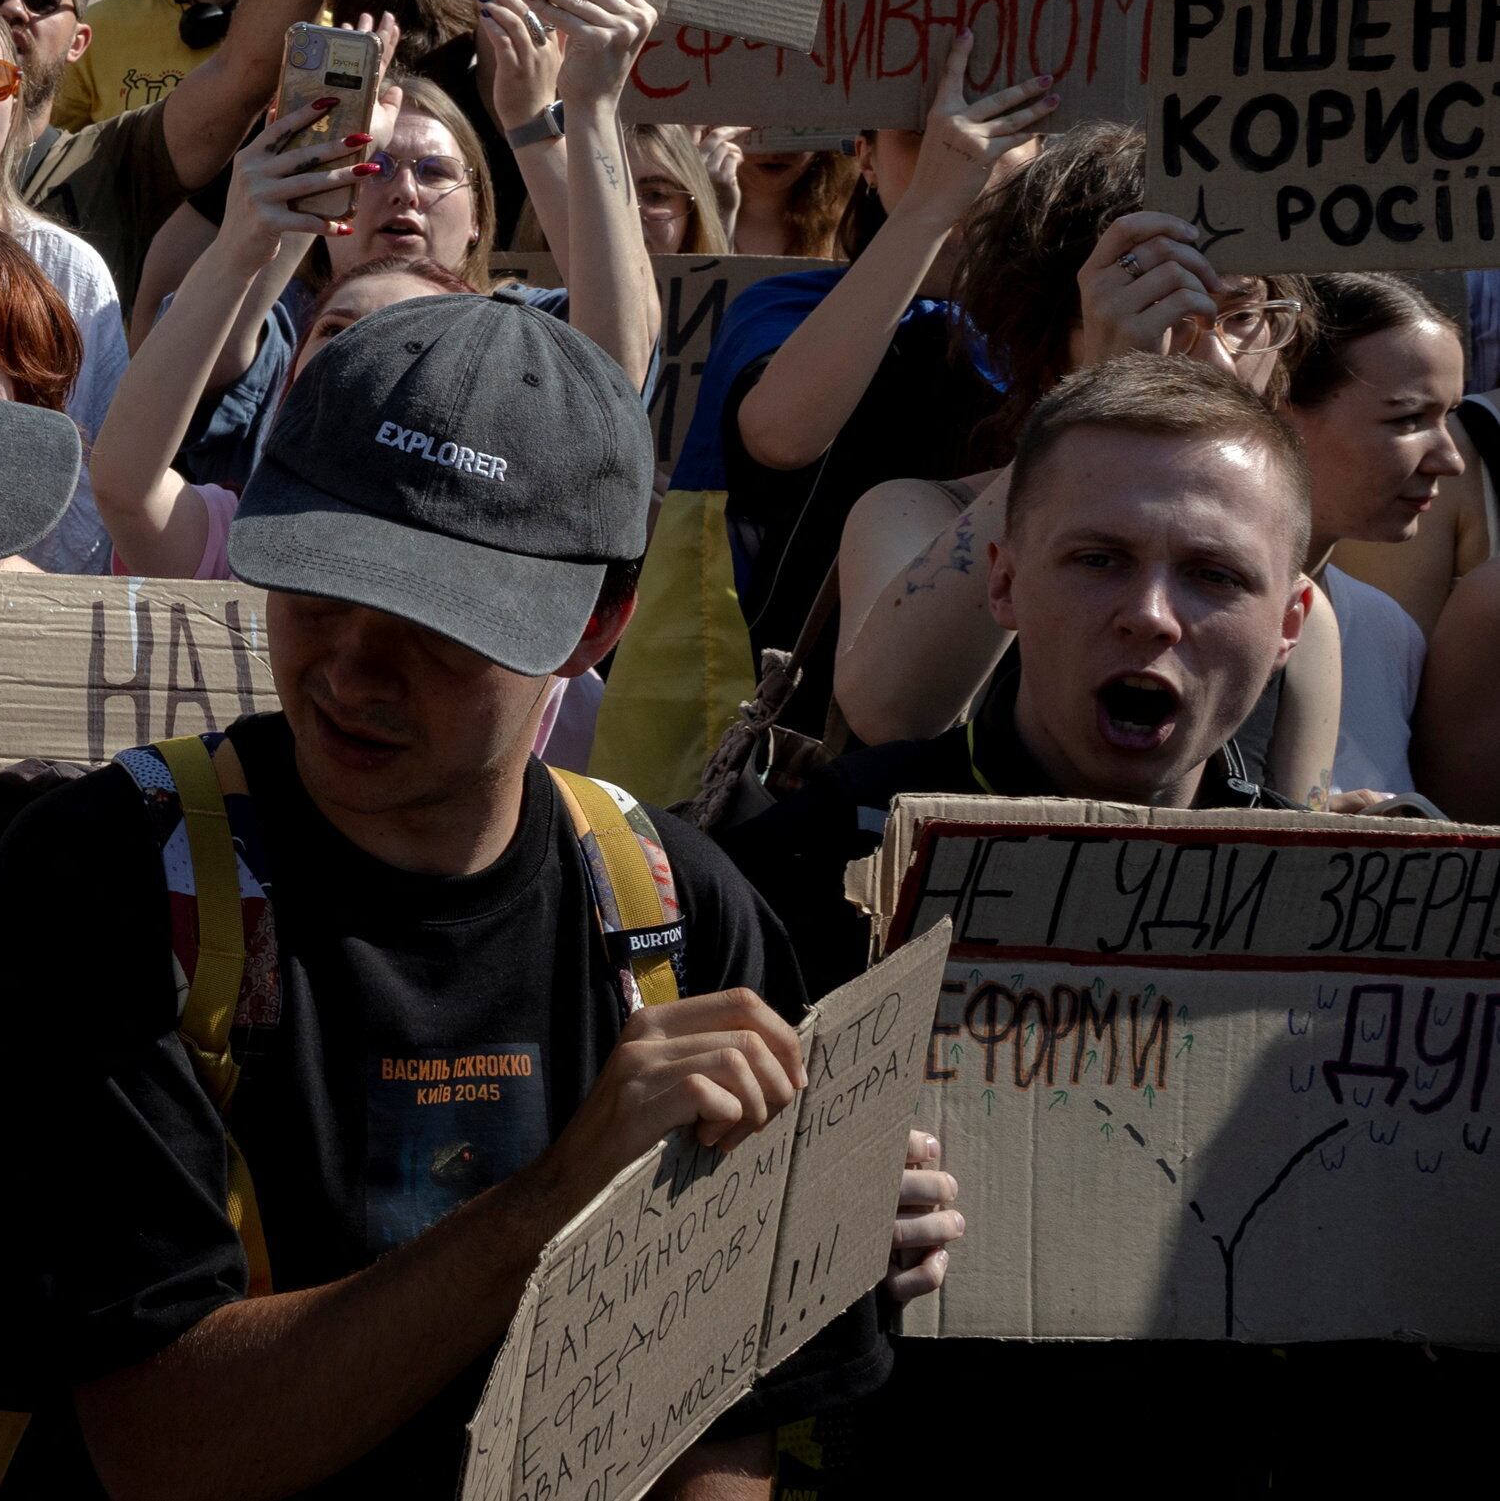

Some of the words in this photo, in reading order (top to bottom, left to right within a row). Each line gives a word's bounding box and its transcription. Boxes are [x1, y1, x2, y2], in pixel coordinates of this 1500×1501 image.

[1162, 80, 1500, 178] КОРИС
[375, 419, 508, 482] EXPLORER
[904, 835, 1030, 946] НЕ
[1047, 834, 1277, 953] ТУДИ
[1309, 849, 1500, 960] ЗВЕРН
[628, 925, 683, 951] BURTON
[379, 1056, 451, 1083] ВАСИЛЬ
[415, 1084, 452, 1107] КИЇВ
[454, 1082, 502, 1104] 2045
